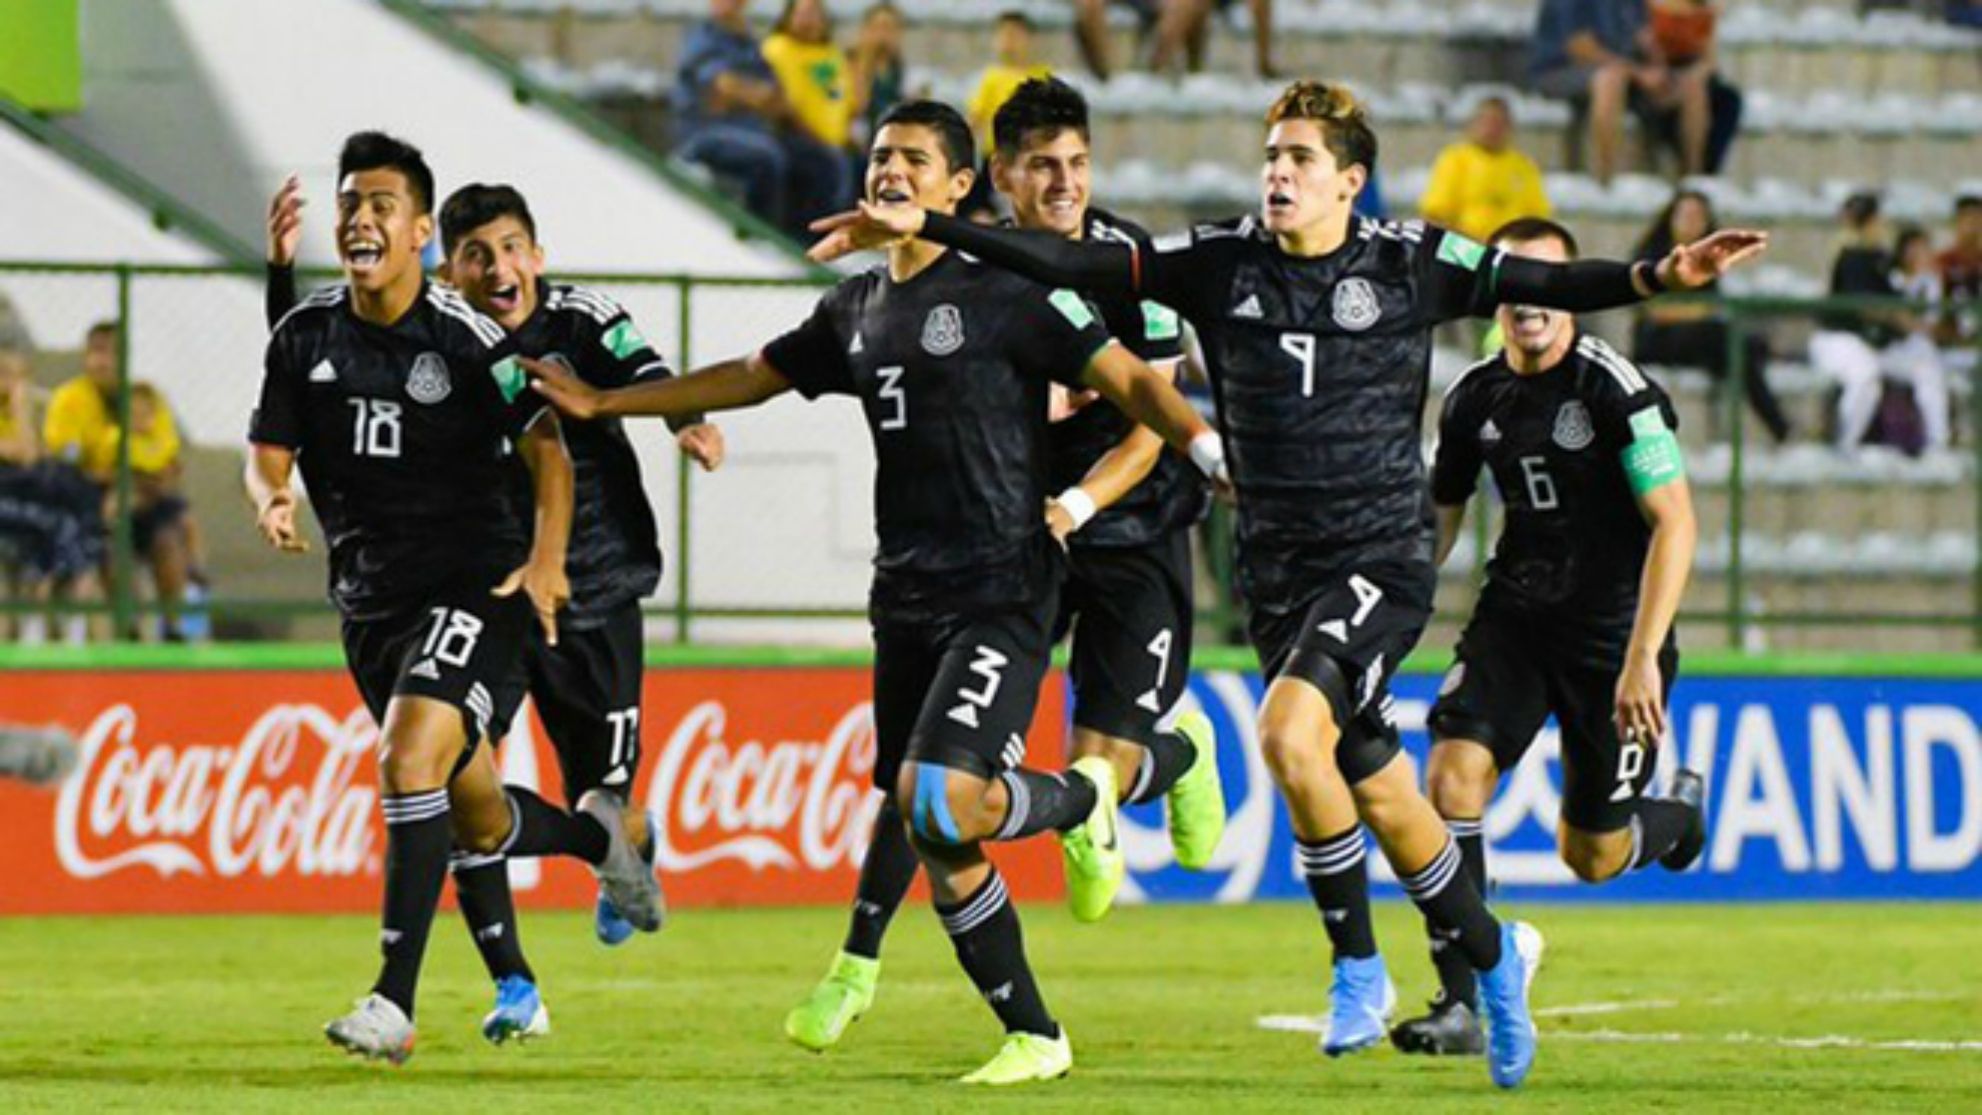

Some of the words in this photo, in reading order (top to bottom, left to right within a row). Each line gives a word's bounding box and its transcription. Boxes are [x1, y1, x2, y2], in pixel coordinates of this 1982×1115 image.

[1279, 332, 1316, 398] 9
[346, 396, 403, 458] 18
[876, 366, 908, 430] 3
[1519, 456, 1559, 510] 6
[422, 606, 485, 668] 18
[957, 644, 1009, 708] 3
[54, 703, 380, 878] Coca-Cola
